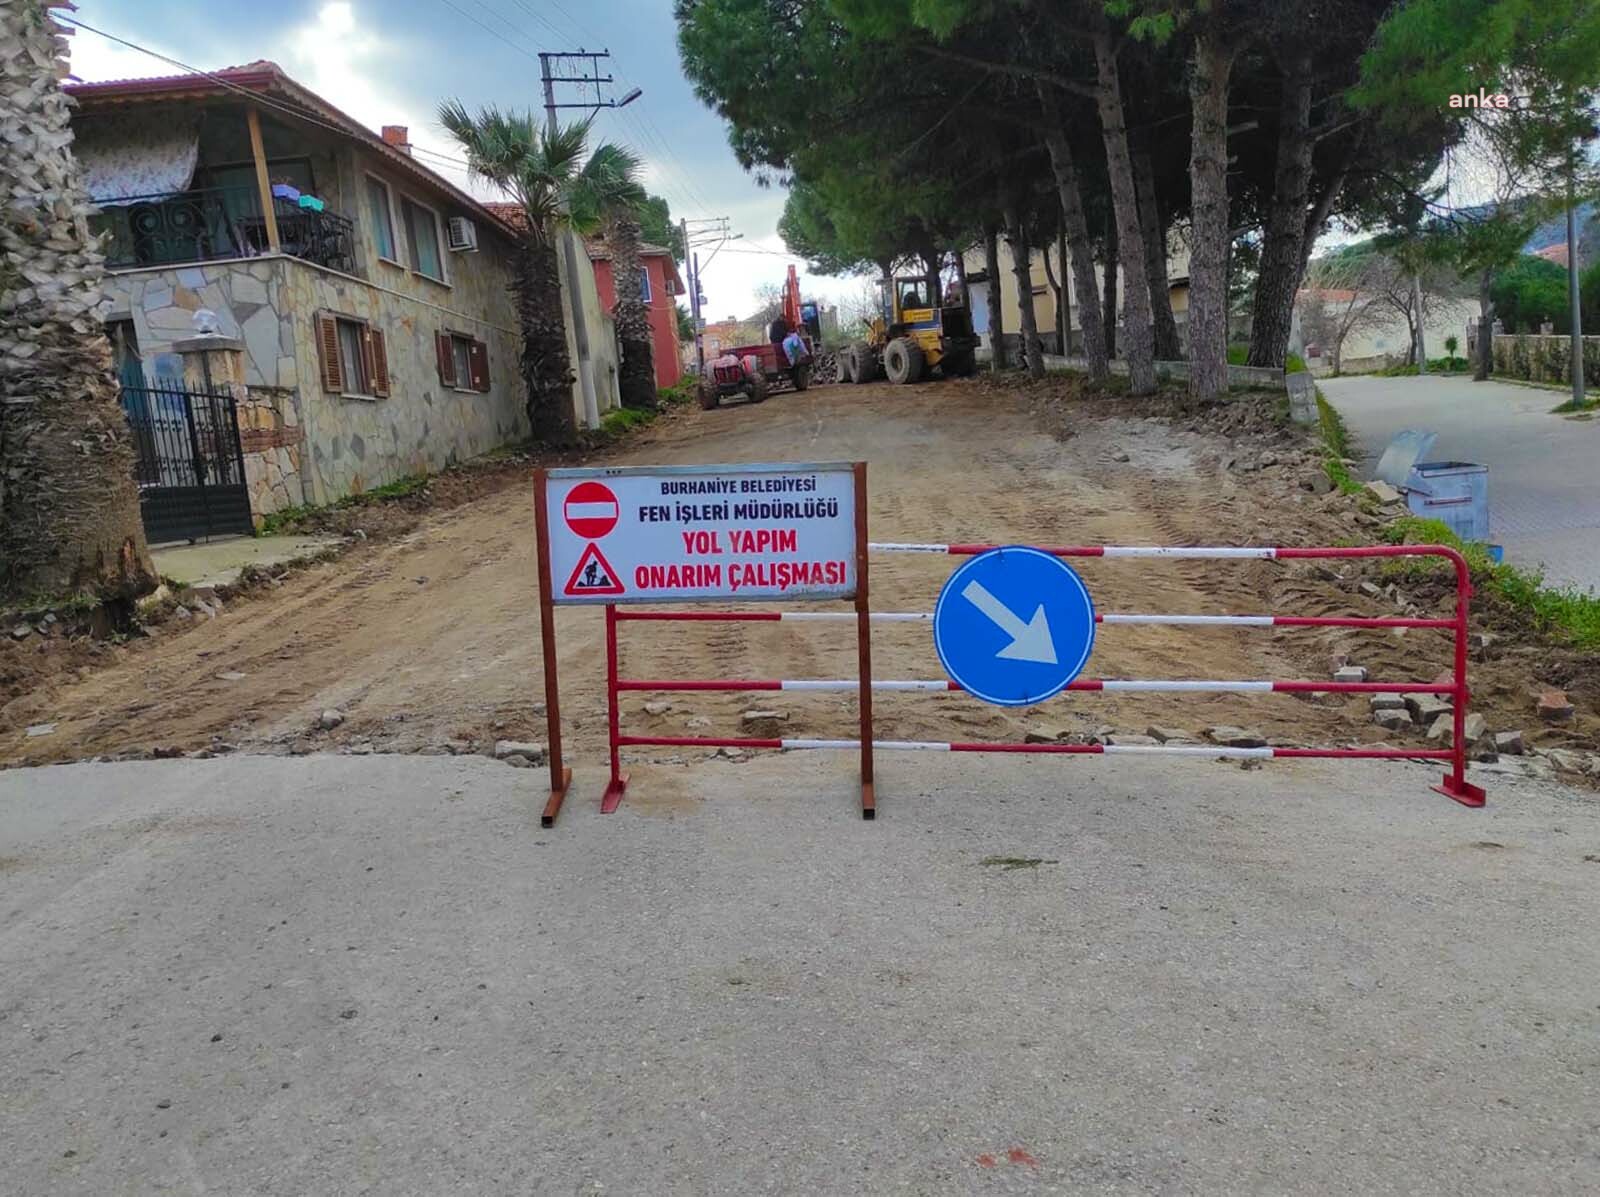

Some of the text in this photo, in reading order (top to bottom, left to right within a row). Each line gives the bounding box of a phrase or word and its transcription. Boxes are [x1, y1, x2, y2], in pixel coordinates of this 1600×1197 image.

[661, 475, 816, 495] BURHANİYE BELEDİYESİ
[639, 497, 838, 524] FEN İŞLERİ MÜDÜRLÜĞÜ
[682, 529, 797, 554] YOL YAPIM
[635, 561, 846, 591] ONARIM ÇALIŞMASI
